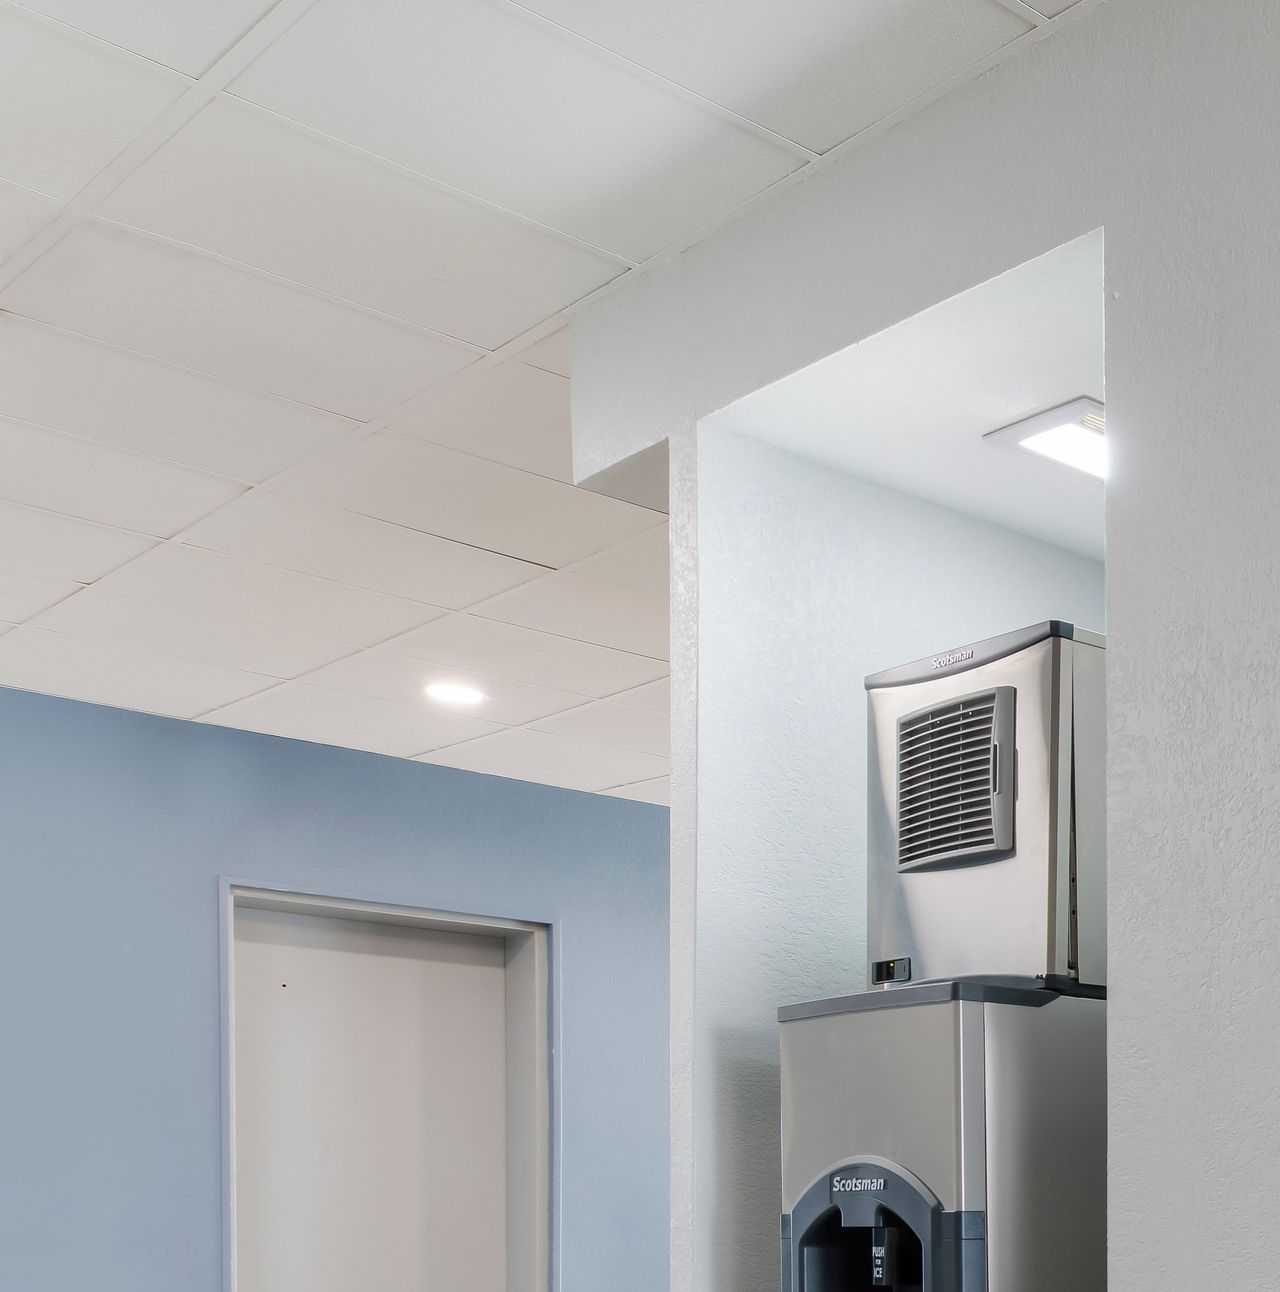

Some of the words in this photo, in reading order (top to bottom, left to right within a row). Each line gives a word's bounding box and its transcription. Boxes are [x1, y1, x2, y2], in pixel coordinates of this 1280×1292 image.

[931, 650, 974, 669] Scotsman
[832, 1176, 885, 1192] Scotsman
[872, 1247, 885, 1257] PUSH
[873, 1267, 883, 1278] ICE
